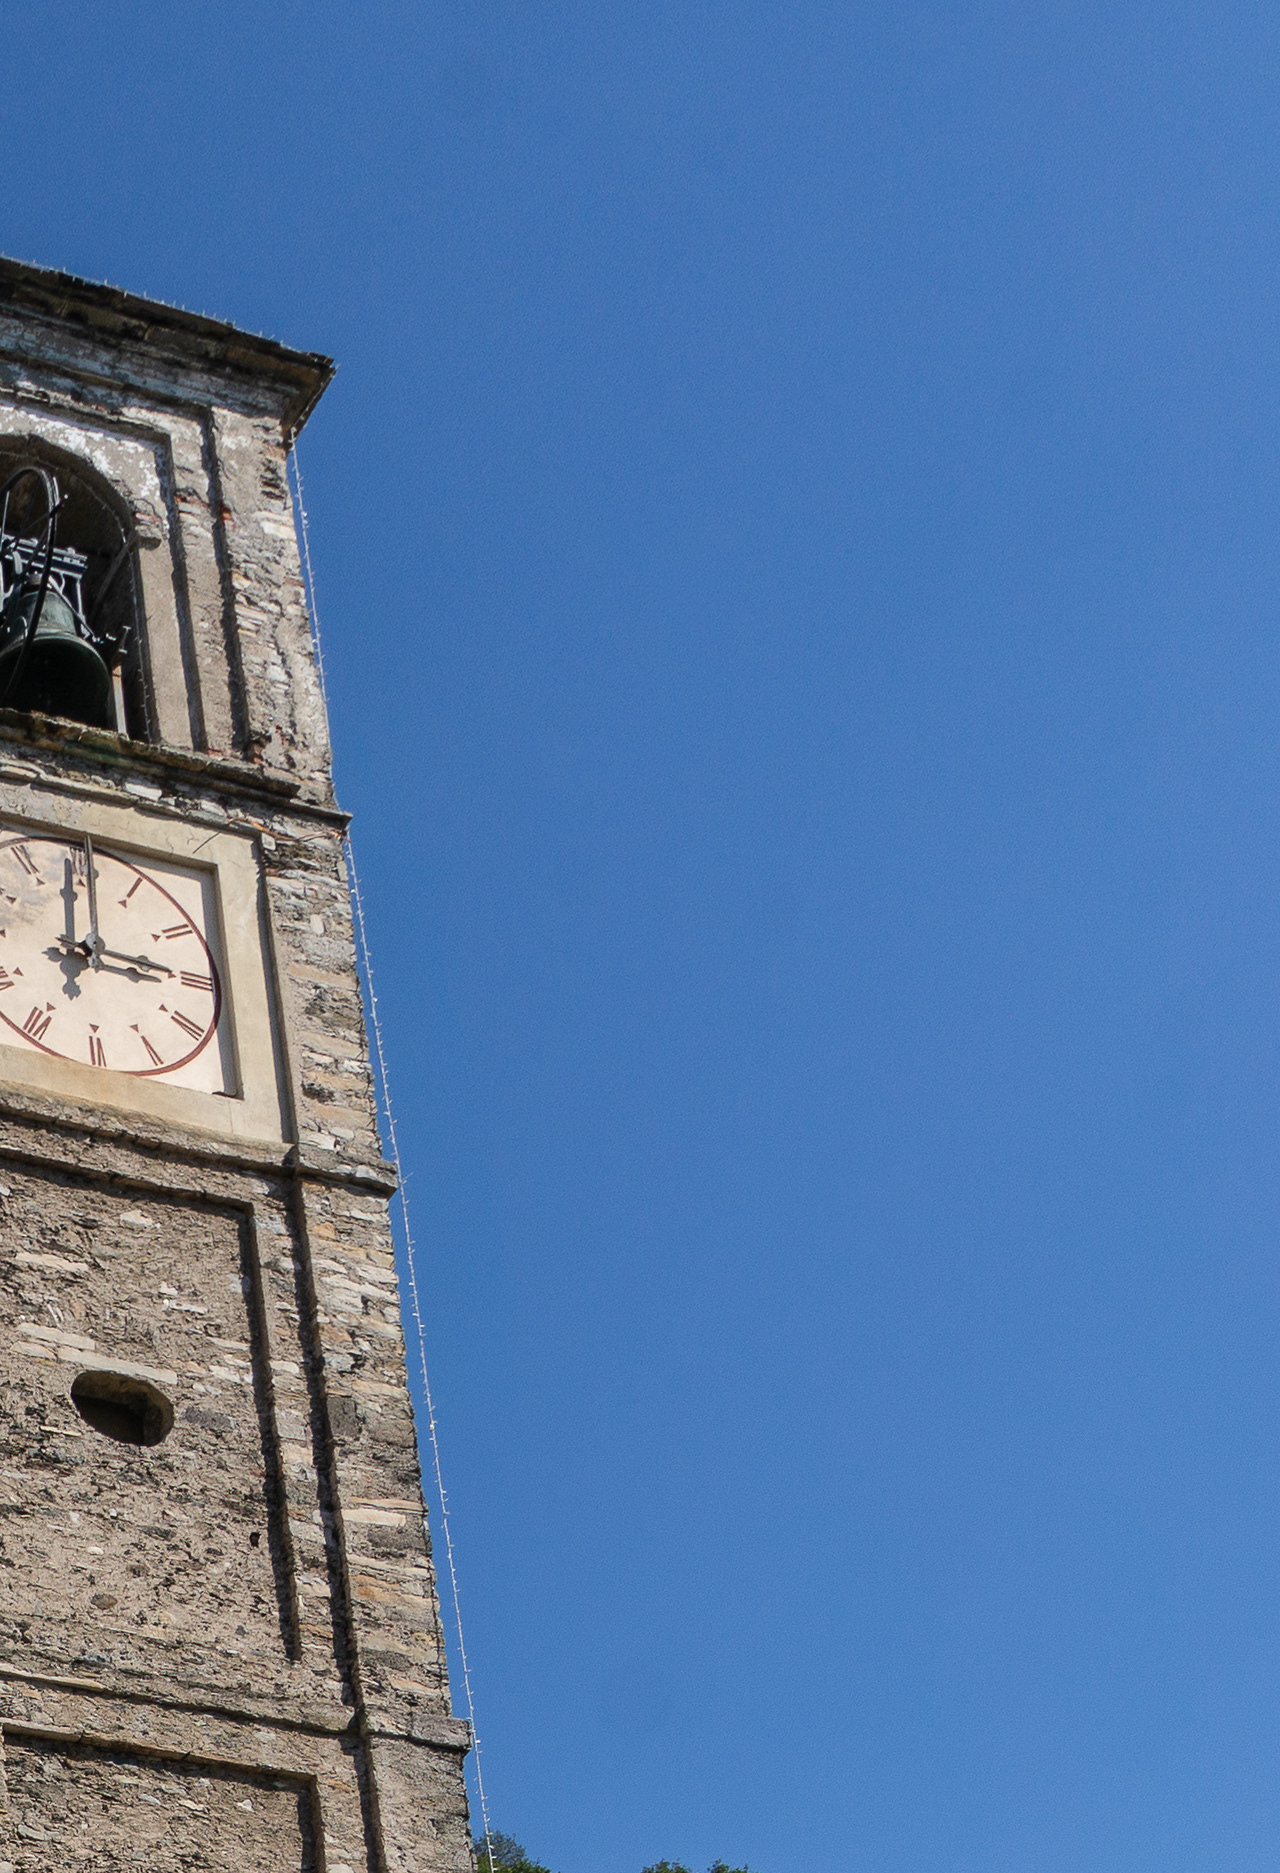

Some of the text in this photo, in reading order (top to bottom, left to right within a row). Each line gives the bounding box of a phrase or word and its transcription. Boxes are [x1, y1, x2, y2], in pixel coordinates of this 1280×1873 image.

[127, 877, 143, 898] I
[162, 924, 194, 940] II
[180, 971, 214, 992] III
[23, 1006, 52, 1040] VII
[171, 1010, 204, 1041] IV
[89, 1036, 107, 1067] VI
[141, 1035, 164, 1066] V
